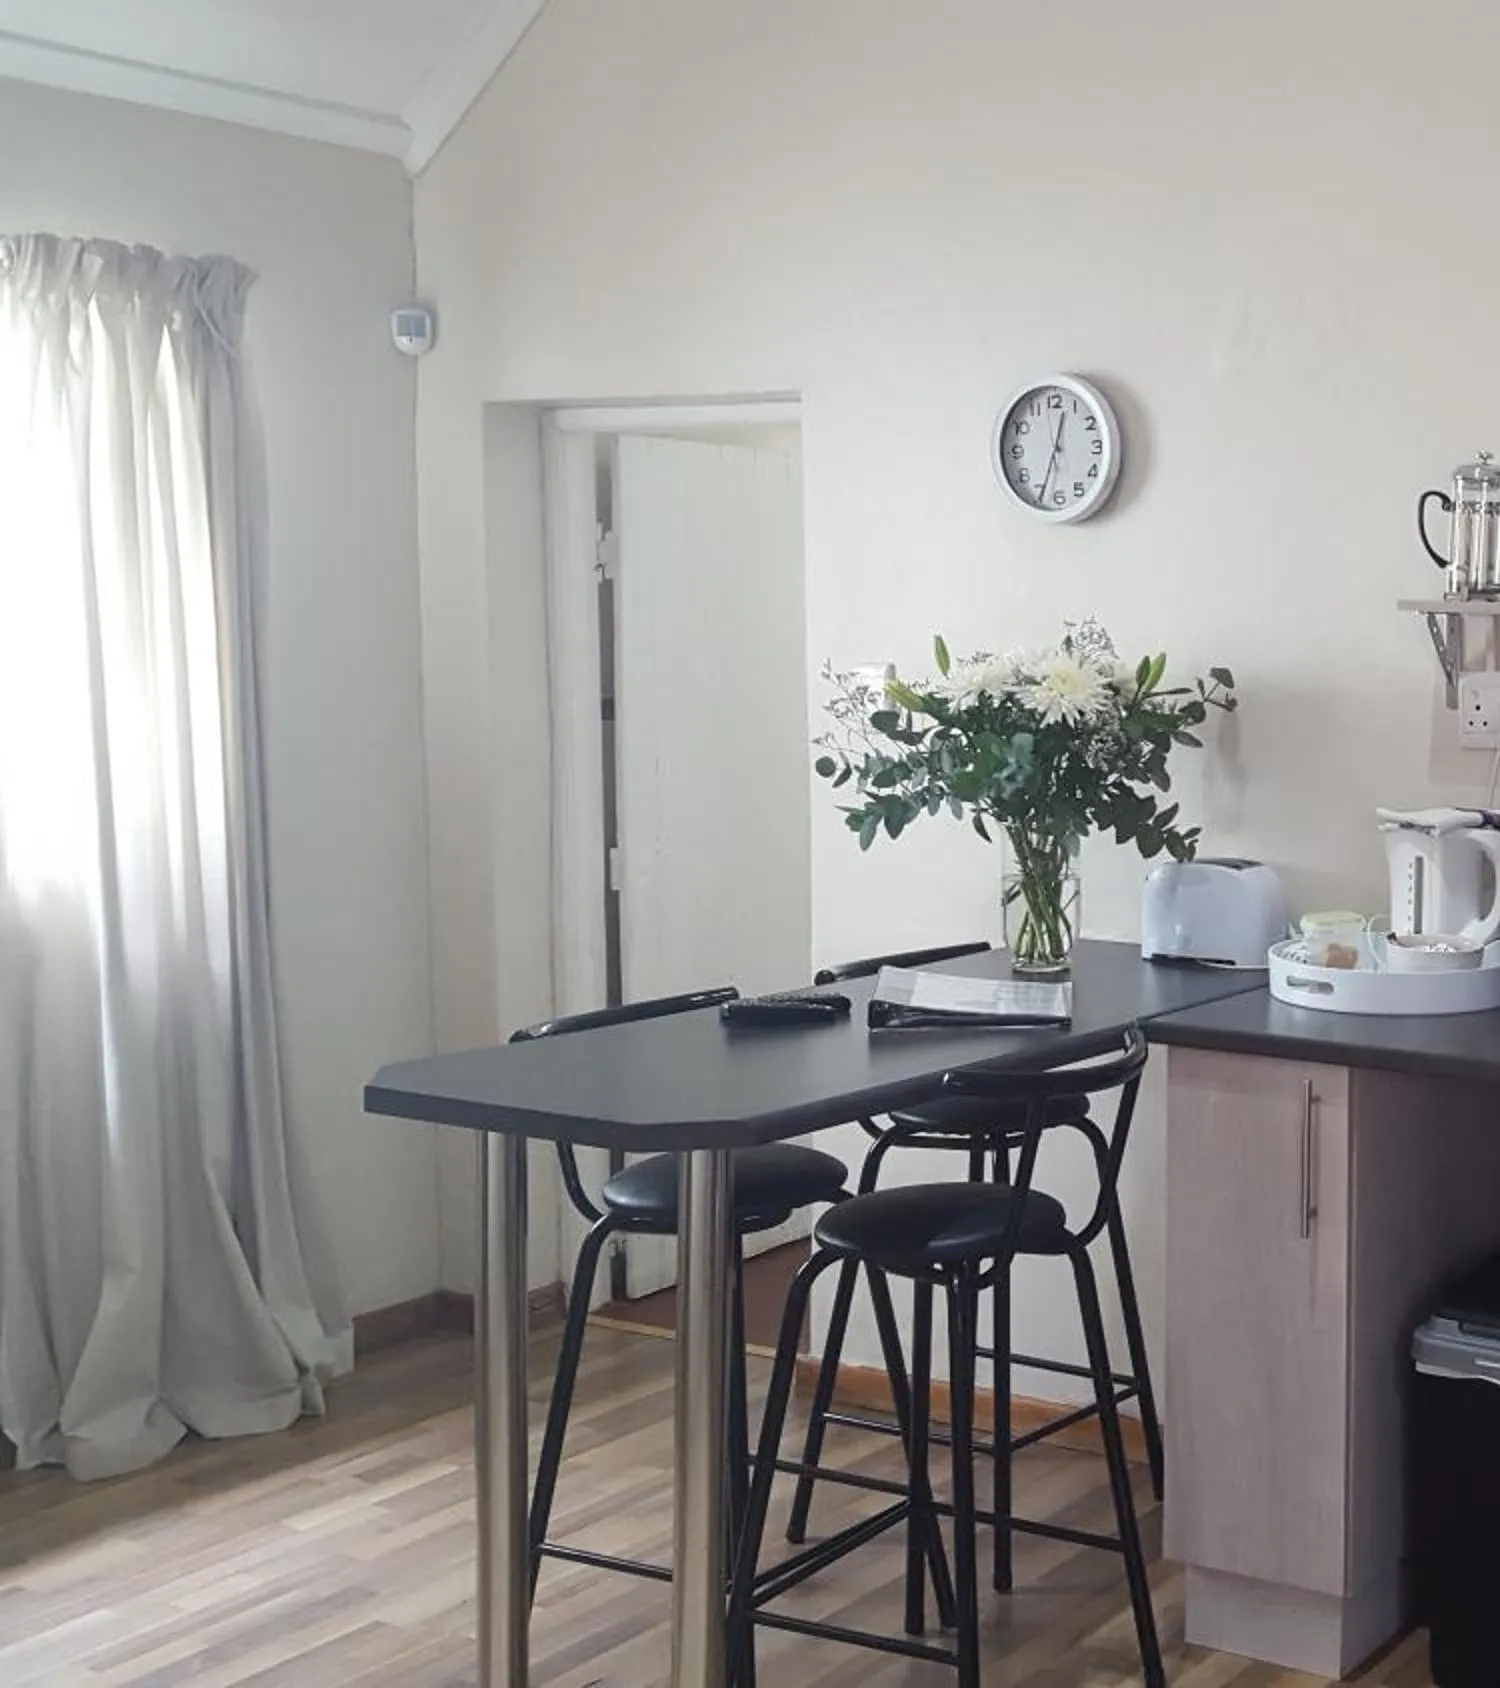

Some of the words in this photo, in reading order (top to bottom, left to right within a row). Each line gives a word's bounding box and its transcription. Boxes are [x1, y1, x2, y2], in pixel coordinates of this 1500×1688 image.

[1028, 398, 1041, 417] 11
[1047, 394, 1063, 409] 12
[1012, 420, 1030, 436] 10
[1084, 416, 1097, 431] 2
[1011, 444, 1024, 460] 9
[1091, 440, 1103, 455] 3
[1018, 467, 1031, 484] 8
[1087, 464, 1098, 478] 4
[1073, 482, 1085, 497] 5
[1053, 490, 1066, 505] 6
